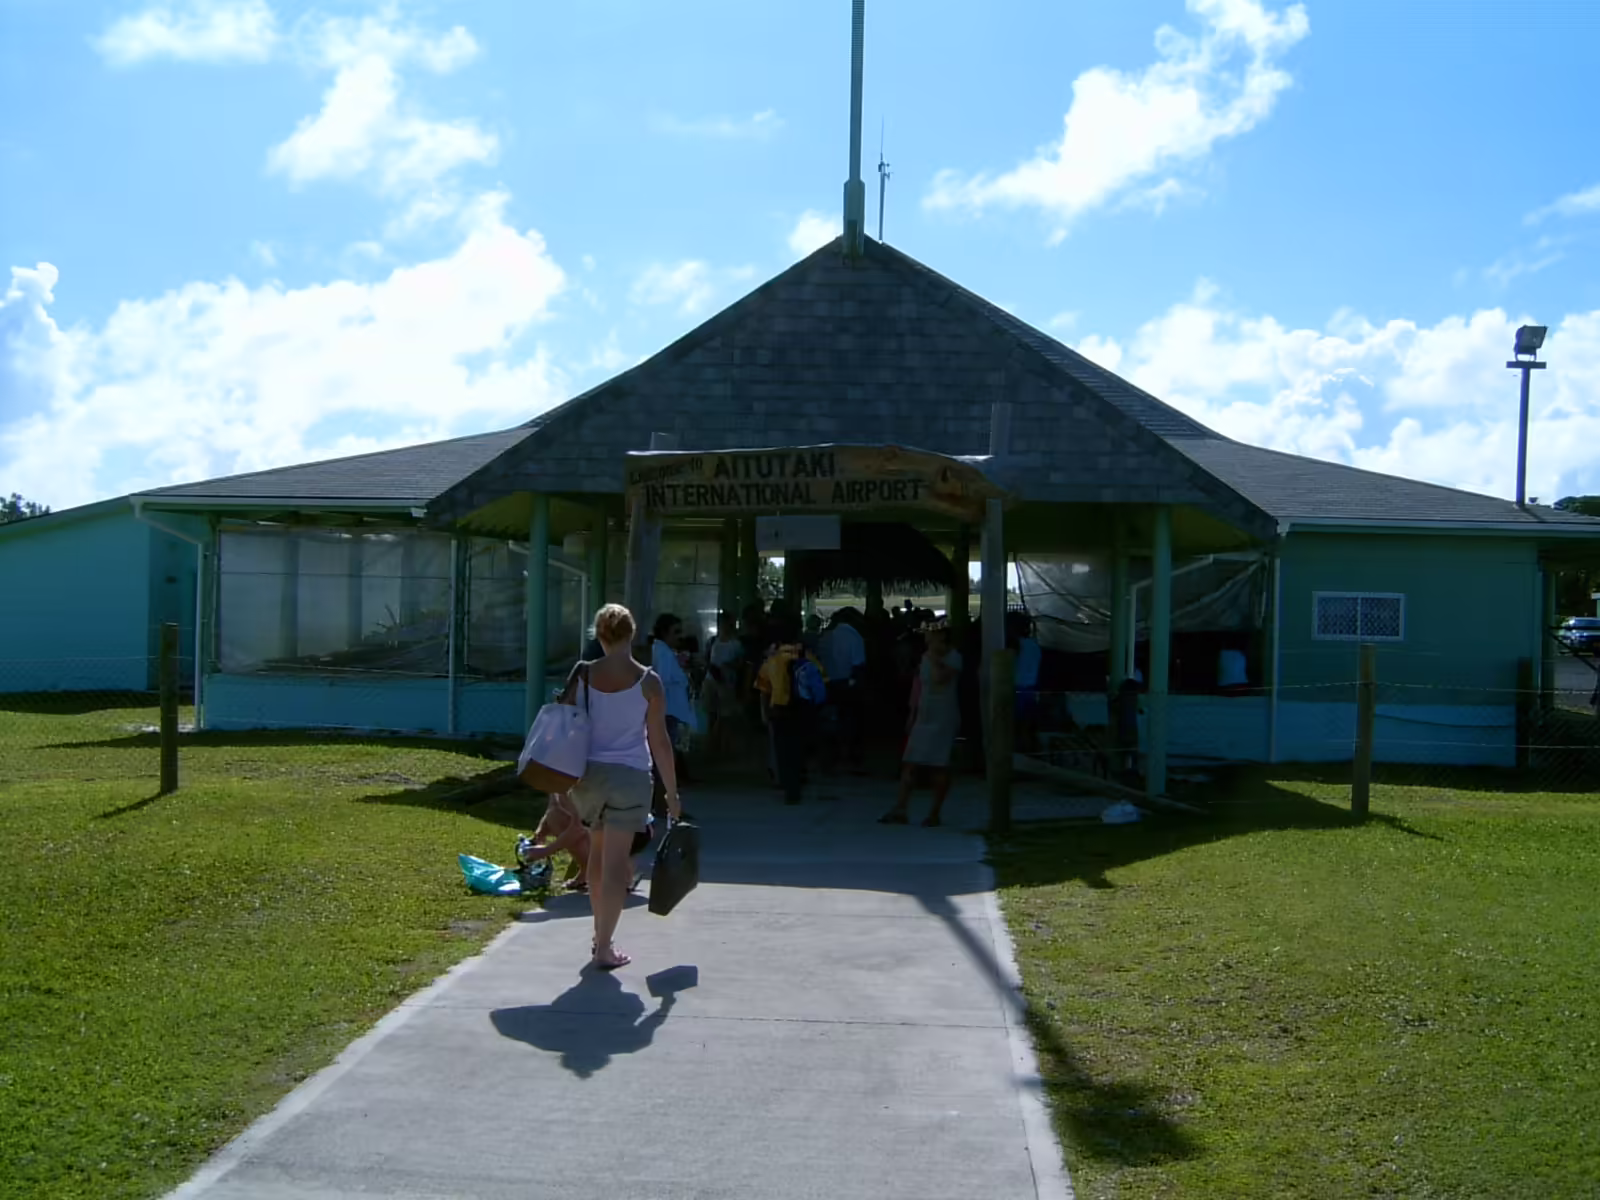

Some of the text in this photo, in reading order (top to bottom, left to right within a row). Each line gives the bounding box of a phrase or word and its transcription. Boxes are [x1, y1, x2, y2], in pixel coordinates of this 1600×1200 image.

[714, 454, 835, 479] AITUTAKI
[646, 478, 924, 508] INTERNATIONAL AIRPORT
